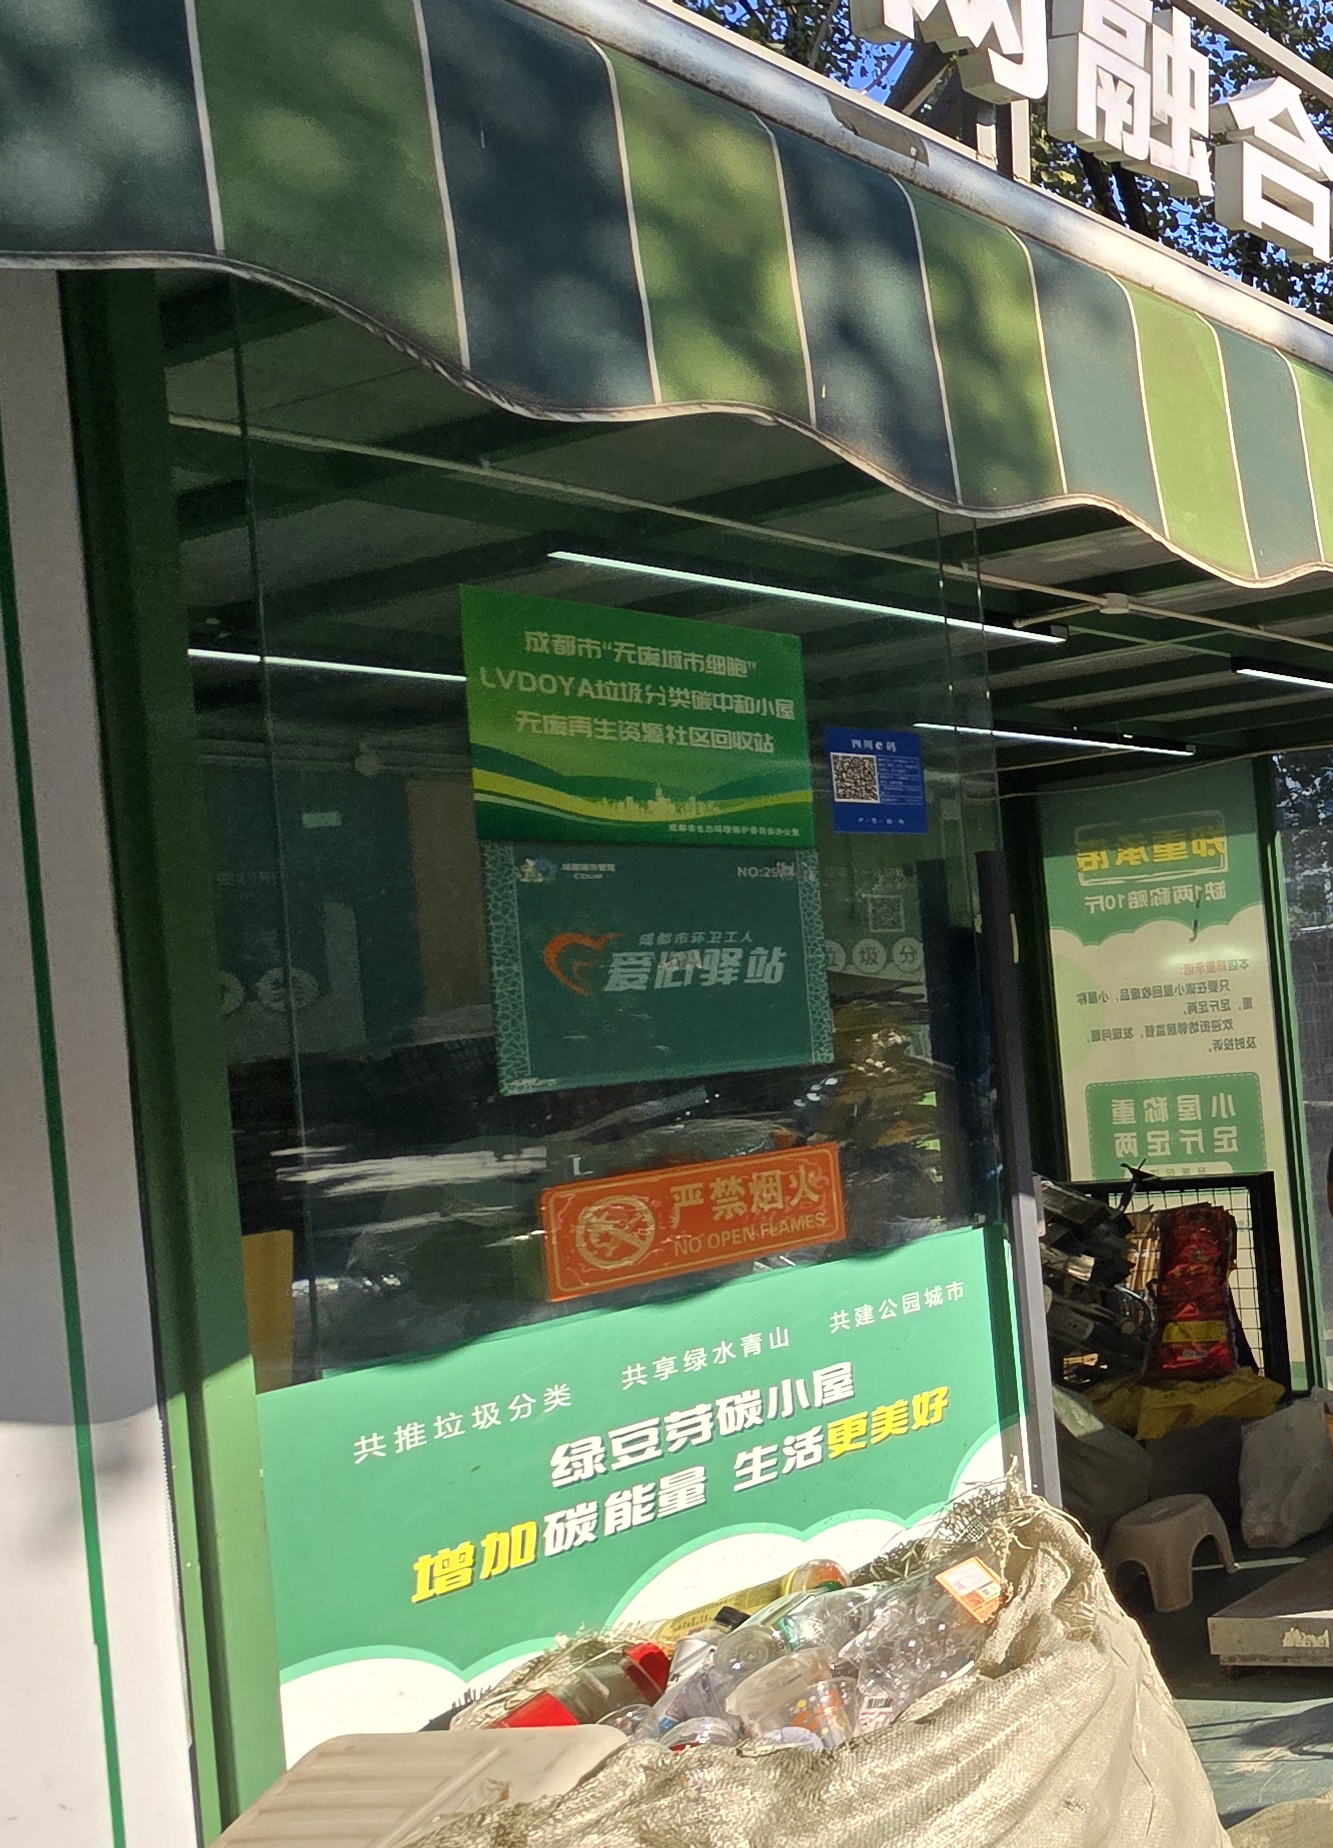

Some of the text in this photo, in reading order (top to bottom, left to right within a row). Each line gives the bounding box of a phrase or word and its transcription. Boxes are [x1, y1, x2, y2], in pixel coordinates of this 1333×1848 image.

[479, 666, 796, 720] LVDOYA垃圾分类碳中和小屋
[515, 710, 775, 754] 无废再生资源社区回收站
[638, 930, 753, 947] 成都市环卫工人
[604, 945, 787, 992] 爱心驿站
[670, 1165, 820, 1229] 严禁烟火
[674, 1212, 829, 1257] NO OPEN FLAMES
[353, 1279, 967, 1462] 共推垃圾分类 共享绿水青山 共建公园城市
[549, 1362, 856, 1489] 绿豆芽碳小屋
[411, 1385, 951, 1604] 增加碳能量 生活更美好
